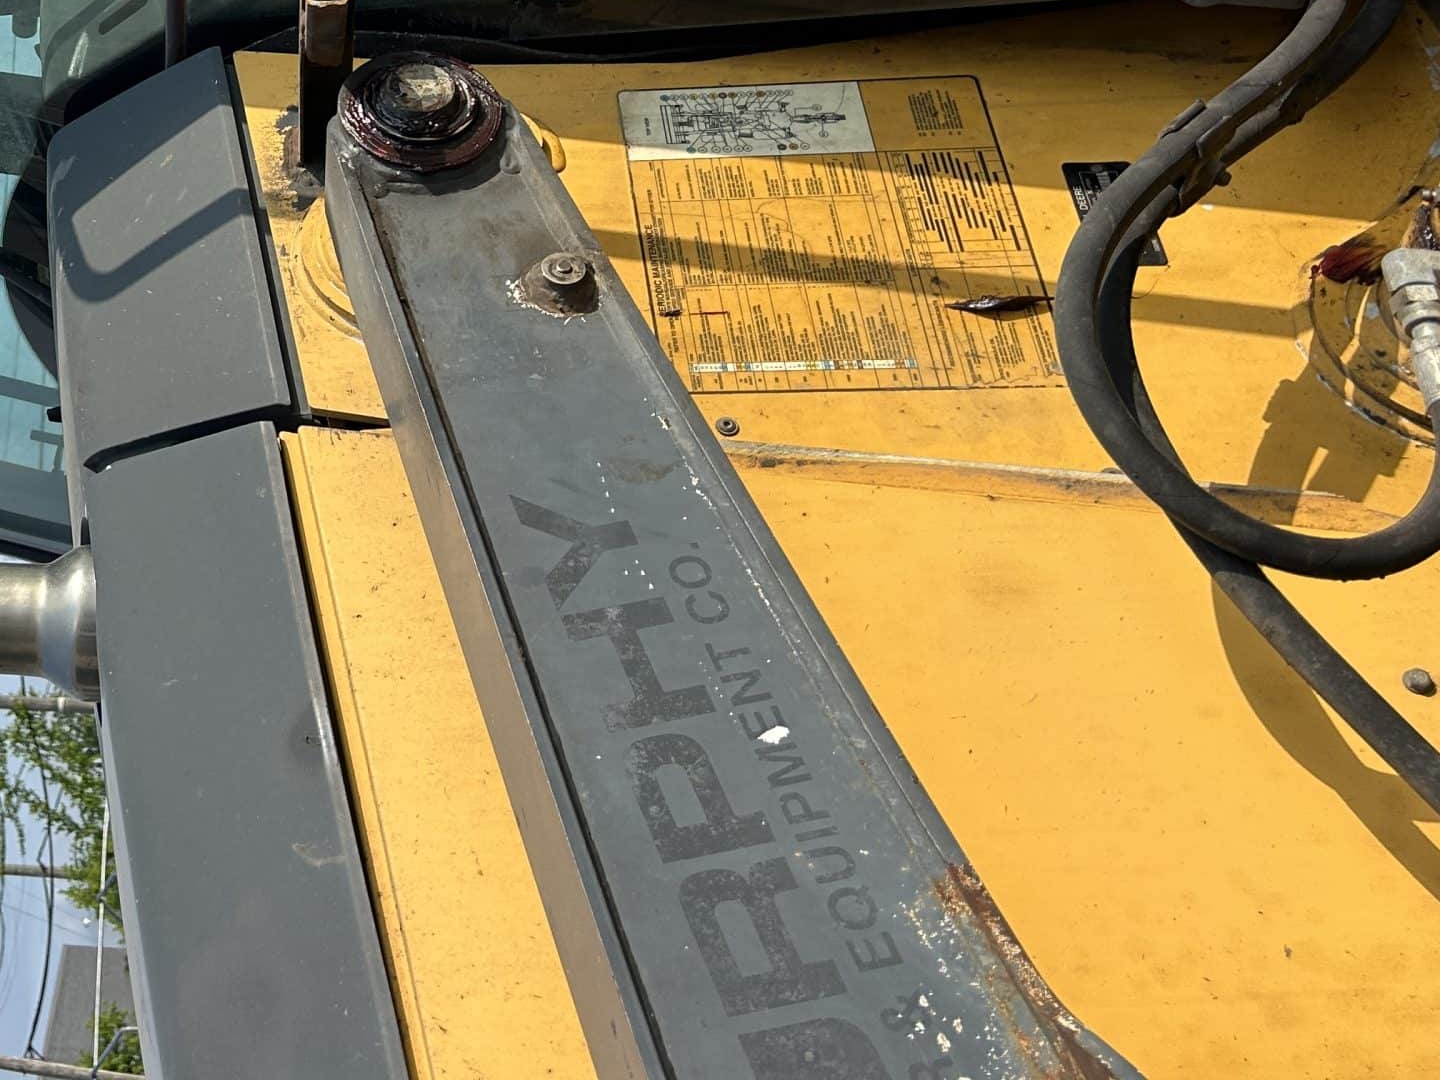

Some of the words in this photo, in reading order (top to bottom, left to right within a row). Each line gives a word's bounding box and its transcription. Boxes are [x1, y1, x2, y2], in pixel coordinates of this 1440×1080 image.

[1072, 185, 1089, 211] DEERE
[644, 224, 660, 279] MAINTENANCE
[668, 540, 731, 625] CO.
[704, 642, 904, 973] EQUIPMENT
